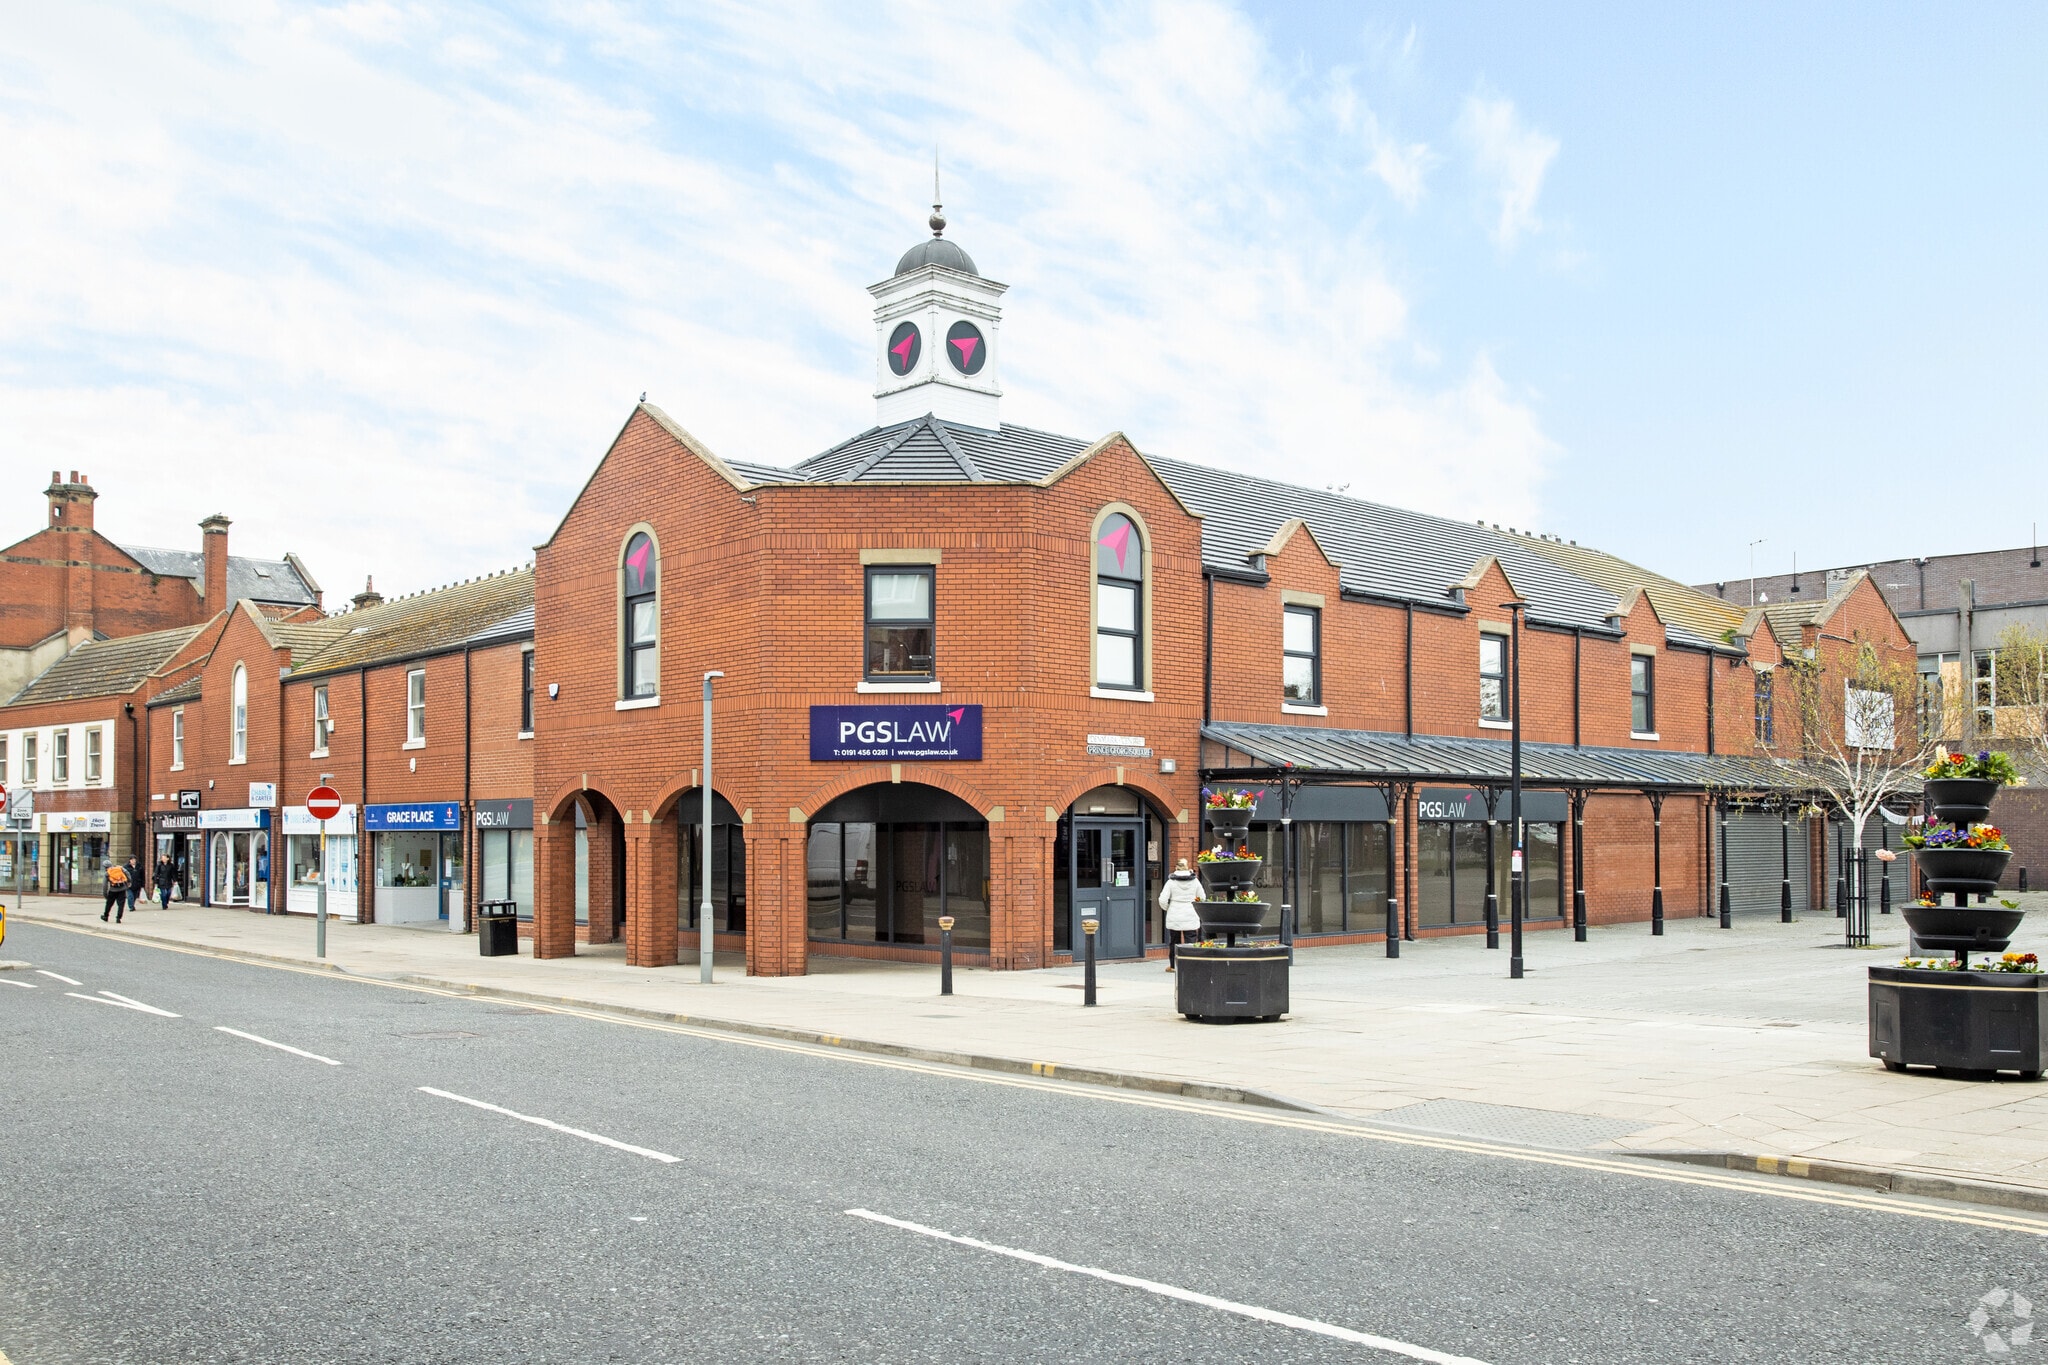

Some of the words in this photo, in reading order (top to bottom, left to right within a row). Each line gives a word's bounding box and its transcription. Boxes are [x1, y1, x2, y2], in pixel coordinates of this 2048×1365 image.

[840, 721, 951, 743] PGSLAW
[897, 749, 959, 757] www.pgslaw.co.uk
[387, 811, 411, 823] GRACE
[411, 810, 434, 823] PLACE
[1419, 801, 1467, 818] PGSLAW
[476, 811, 510, 826] PGSLAW
